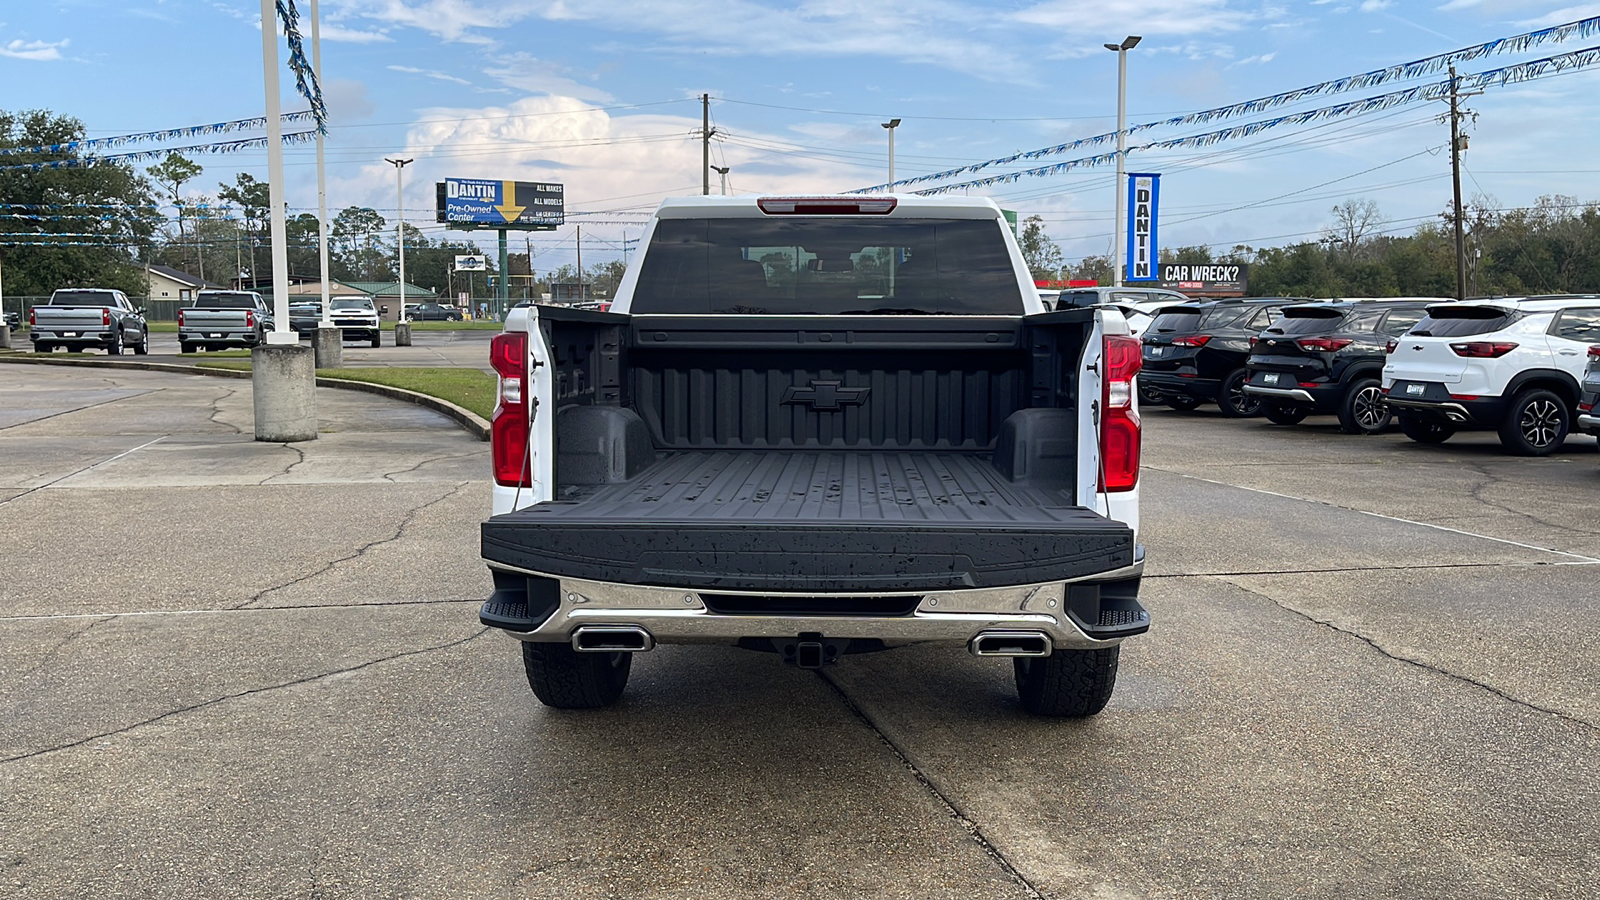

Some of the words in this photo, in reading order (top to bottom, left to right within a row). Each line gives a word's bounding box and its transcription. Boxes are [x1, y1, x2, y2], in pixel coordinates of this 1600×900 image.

[447, 181, 495, 198] DANTIN
[543, 198, 563, 206] MODELS
[447, 204, 492, 214] Pre-Owned
[447, 213, 474, 221] Center
[1136, 190, 1149, 276] DANTIN
[1165, 266, 1188, 281] CAR
[1191, 266, 1239, 281] WRECK?
